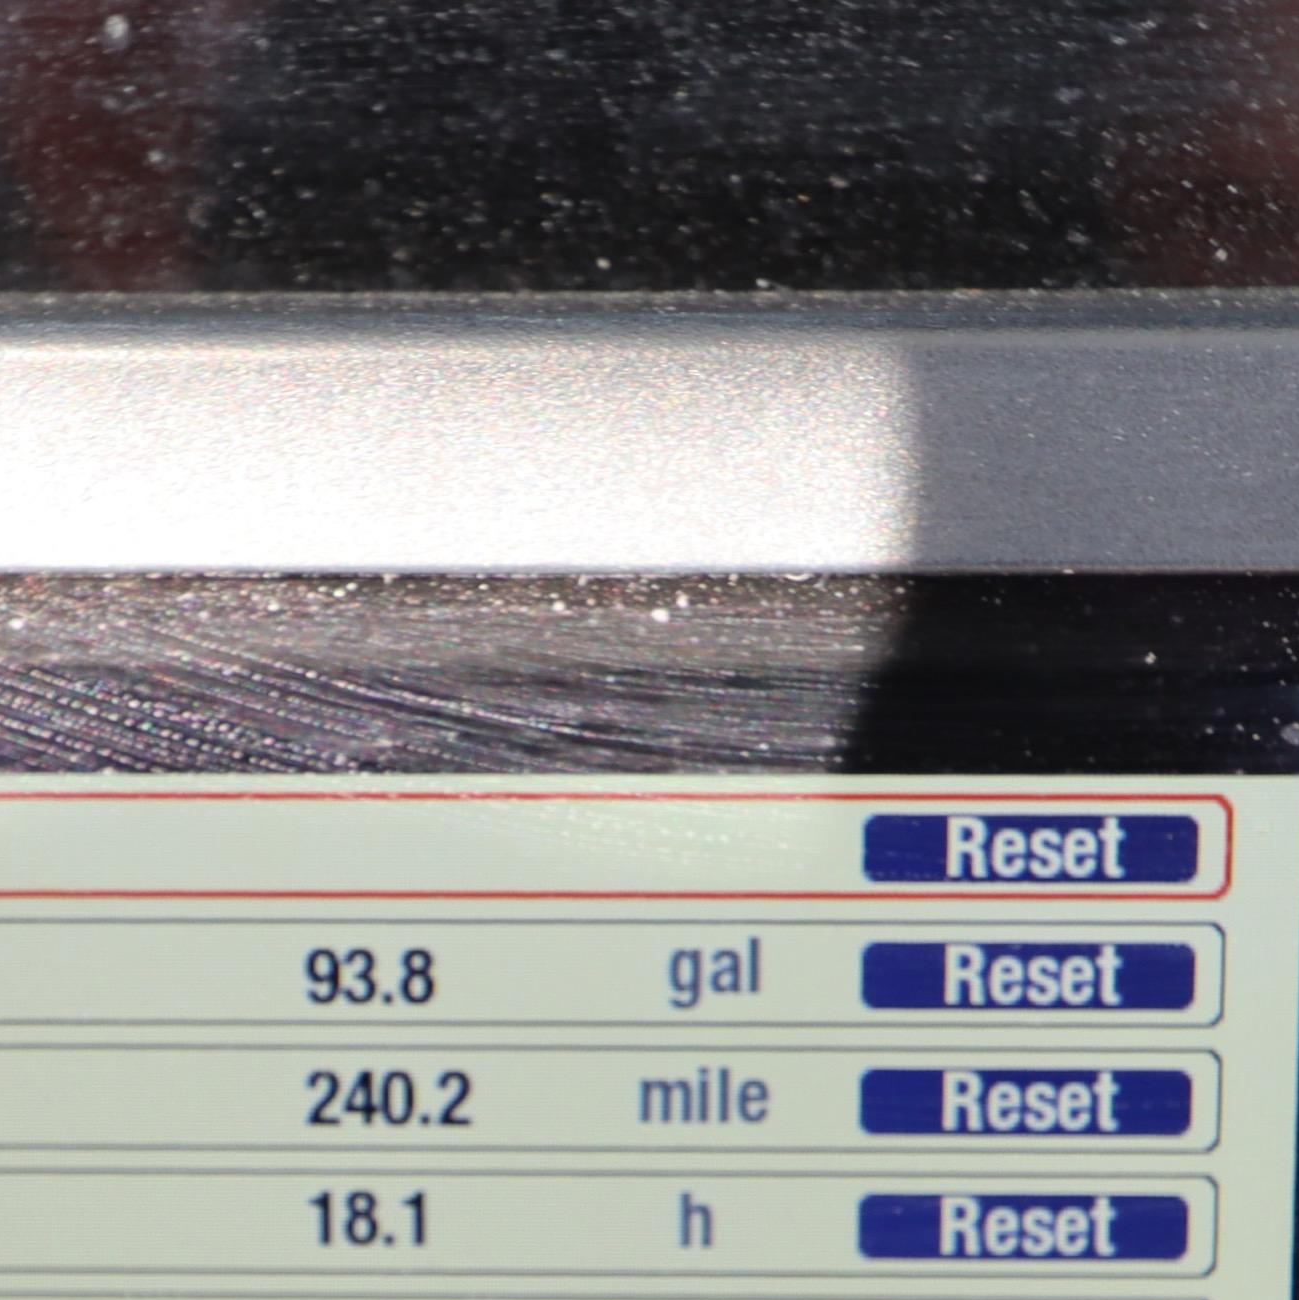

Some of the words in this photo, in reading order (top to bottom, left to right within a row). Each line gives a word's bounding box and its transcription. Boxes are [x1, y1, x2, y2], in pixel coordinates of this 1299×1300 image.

[945, 815, 1126, 879] Reset
[305, 948, 436, 1003] 93.8
[668, 938, 761, 1009] gal
[943, 943, 1122, 1007] Reset
[305, 1071, 473, 1126] 240.2
[639, 1068, 770, 1124] mile
[940, 1071, 1120, 1132] Reset
[308, 1192, 429, 1247] 18.1
[679, 1193, 713, 1248] h
[939, 1196, 1117, 1256] Reset
